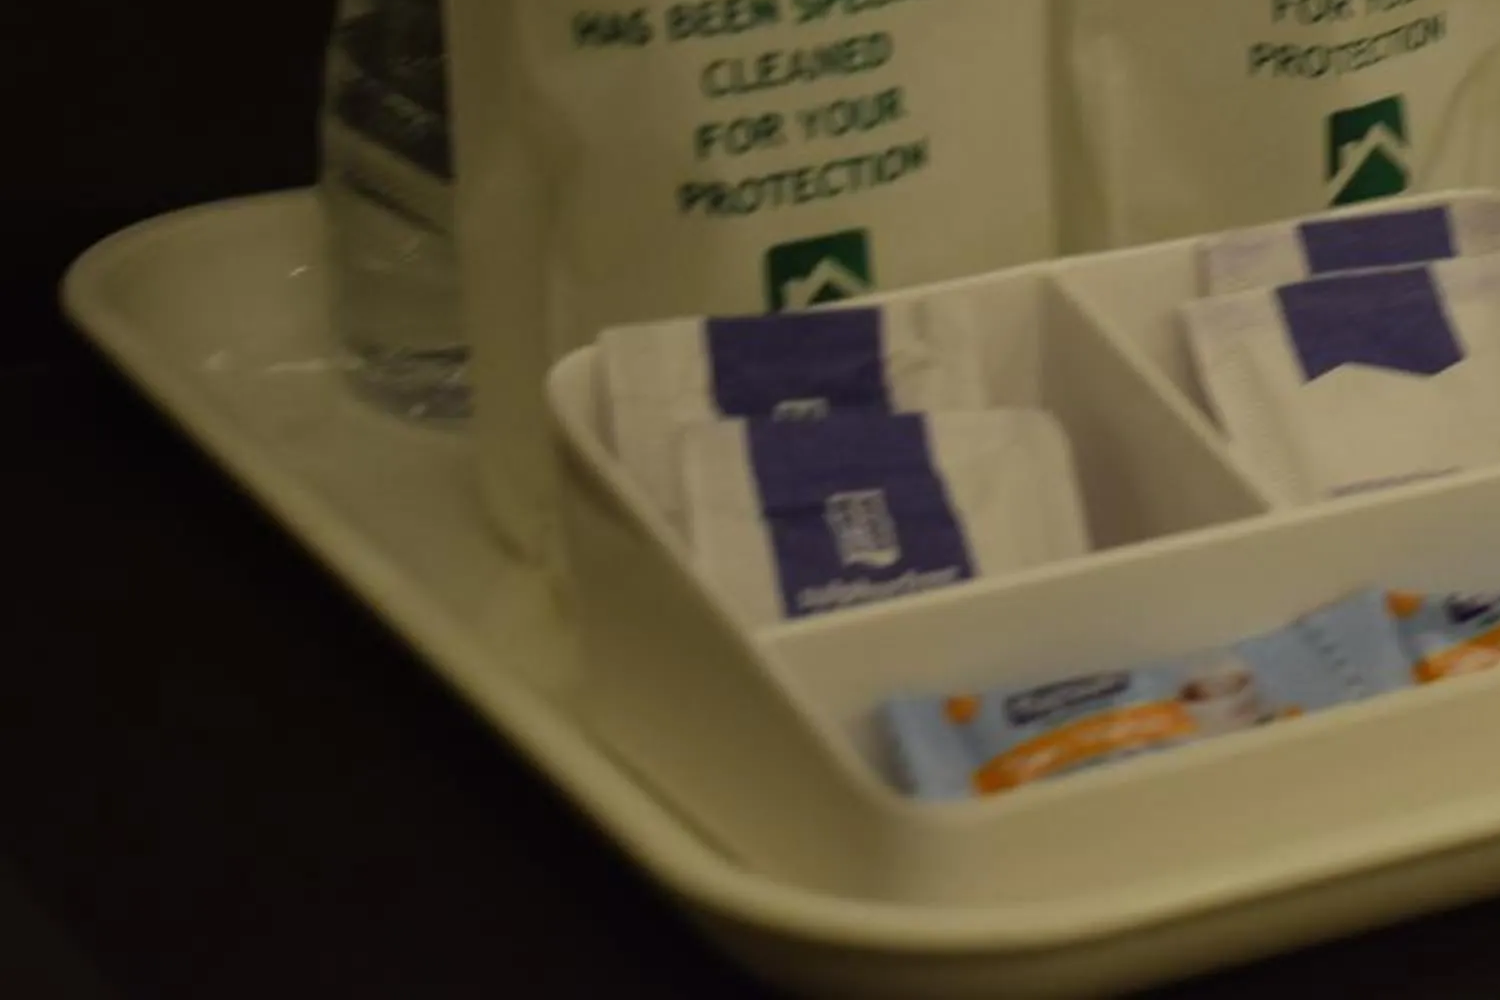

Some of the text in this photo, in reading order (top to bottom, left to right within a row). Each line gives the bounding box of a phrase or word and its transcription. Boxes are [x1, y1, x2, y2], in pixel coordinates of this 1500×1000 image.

[572, 8, 652, 48] HAS
[1249, 12, 1446, 78] PROTECTION
[701, 31, 894, 98] CLEANED
[695, 87, 906, 161] FOR YOUR
[677, 138, 930, 217] PROTECTION
